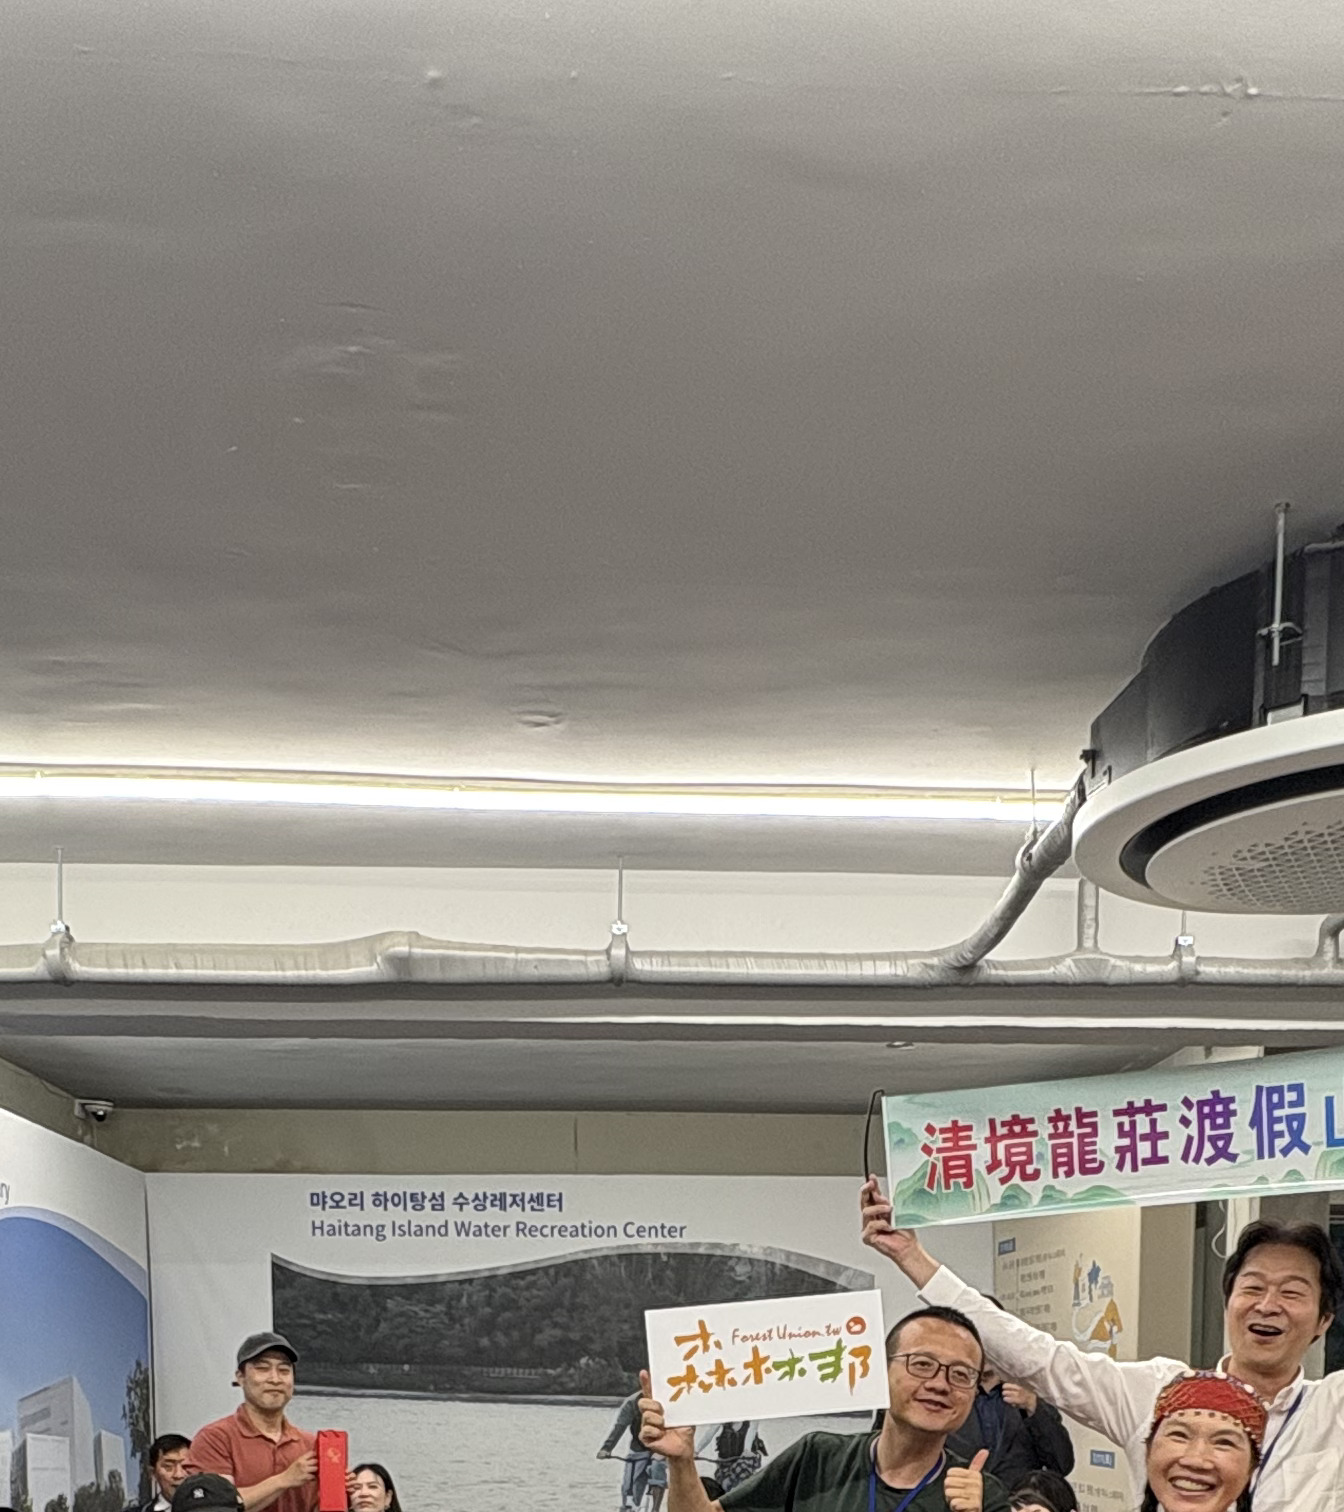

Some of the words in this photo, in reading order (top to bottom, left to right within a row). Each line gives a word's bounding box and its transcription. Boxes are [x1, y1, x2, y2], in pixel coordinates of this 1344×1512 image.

[309, 1190, 364, 1212] 먀오리
[371, 1190, 446, 1212] 하이탕섬
[451, 1191, 564, 1213] 수상레저센터
[311, 1219, 386, 1241] Haitang
[391, 1219, 449, 1238] Island
[454, 1220, 511, 1239] Water
[515, 1220, 618, 1239] Recreation
[623, 1221, 687, 1239] Center
[732, 1327, 773, 1345] Forest
